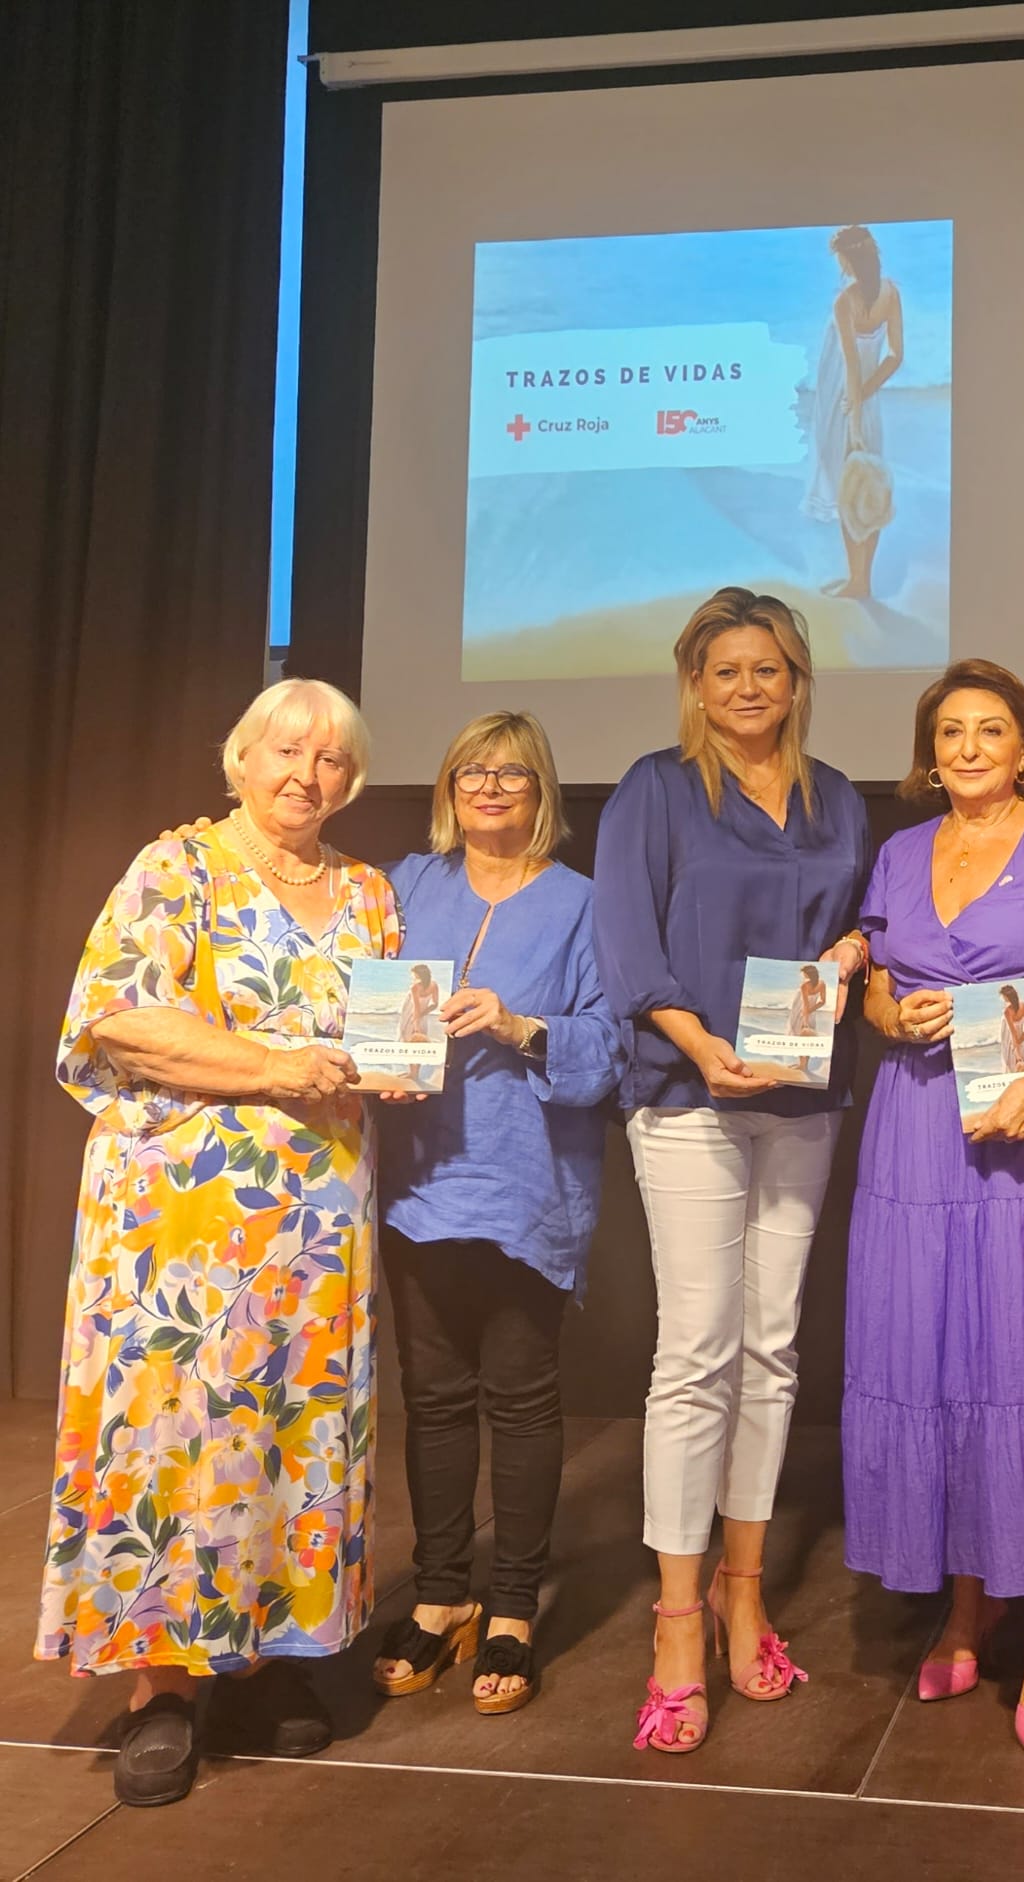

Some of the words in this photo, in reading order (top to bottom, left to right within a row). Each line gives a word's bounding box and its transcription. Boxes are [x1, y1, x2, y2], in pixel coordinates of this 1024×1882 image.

[506, 368, 607, 389] TRAZOS
[619, 366, 651, 385] DE
[663, 363, 743, 383] VIDAS
[537, 418, 573, 434] Cruz
[576, 416, 610, 434] Roja
[696, 417, 720, 426] ANYS
[688, 424, 728, 435] ALACANT
[363, 1047, 395, 1055] TRAZOS
[399, 1047, 409, 1055] DE
[413, 1048, 437, 1056] VIDAS
